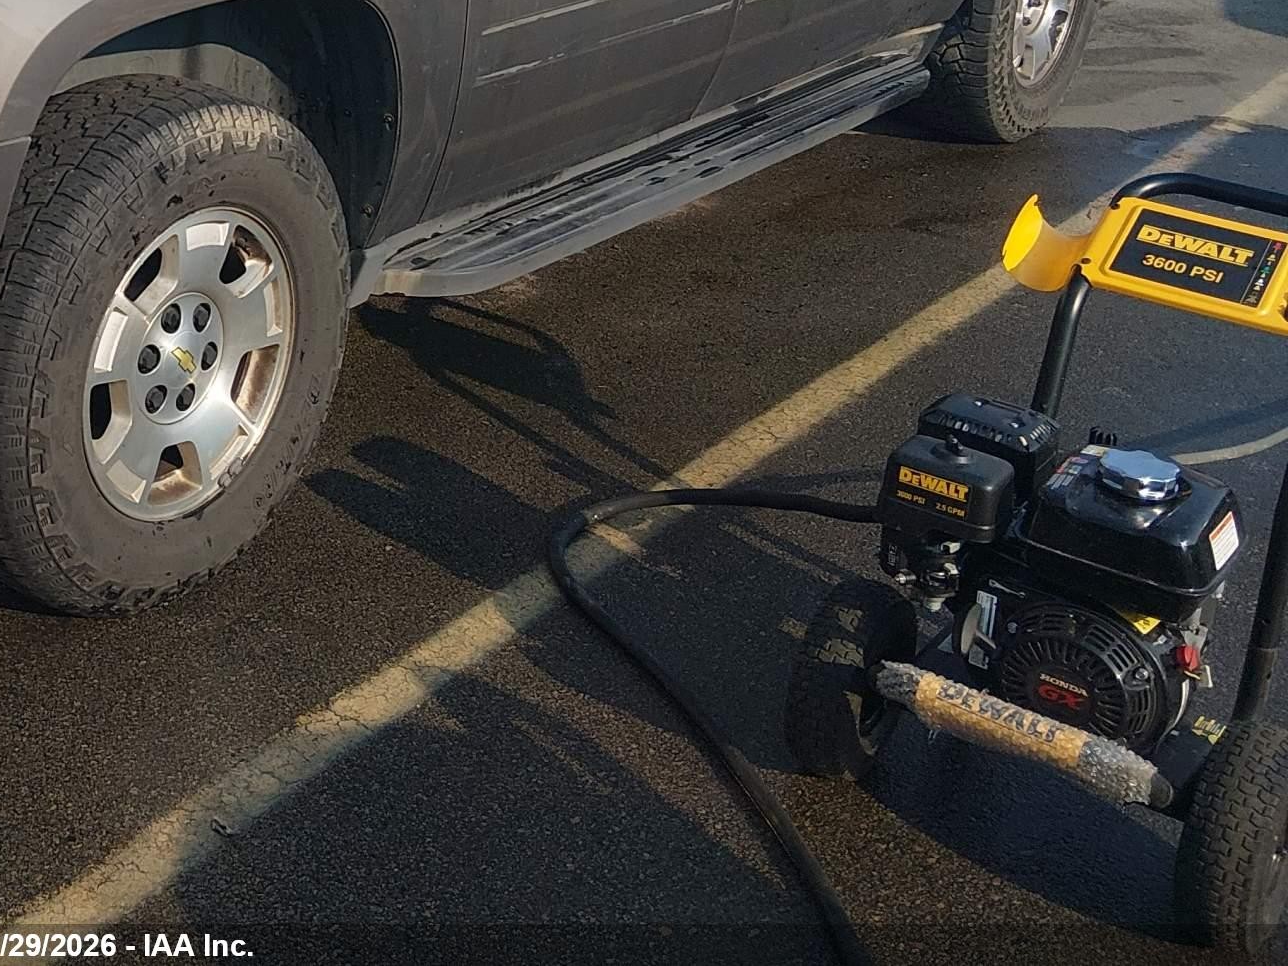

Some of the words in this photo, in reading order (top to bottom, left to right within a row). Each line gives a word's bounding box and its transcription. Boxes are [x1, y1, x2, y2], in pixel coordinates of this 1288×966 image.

[1142, 254, 1187, 274] 3600
[1189, 265, 1224, 284] PSI
[1039, 673, 1089, 698] HONDA
